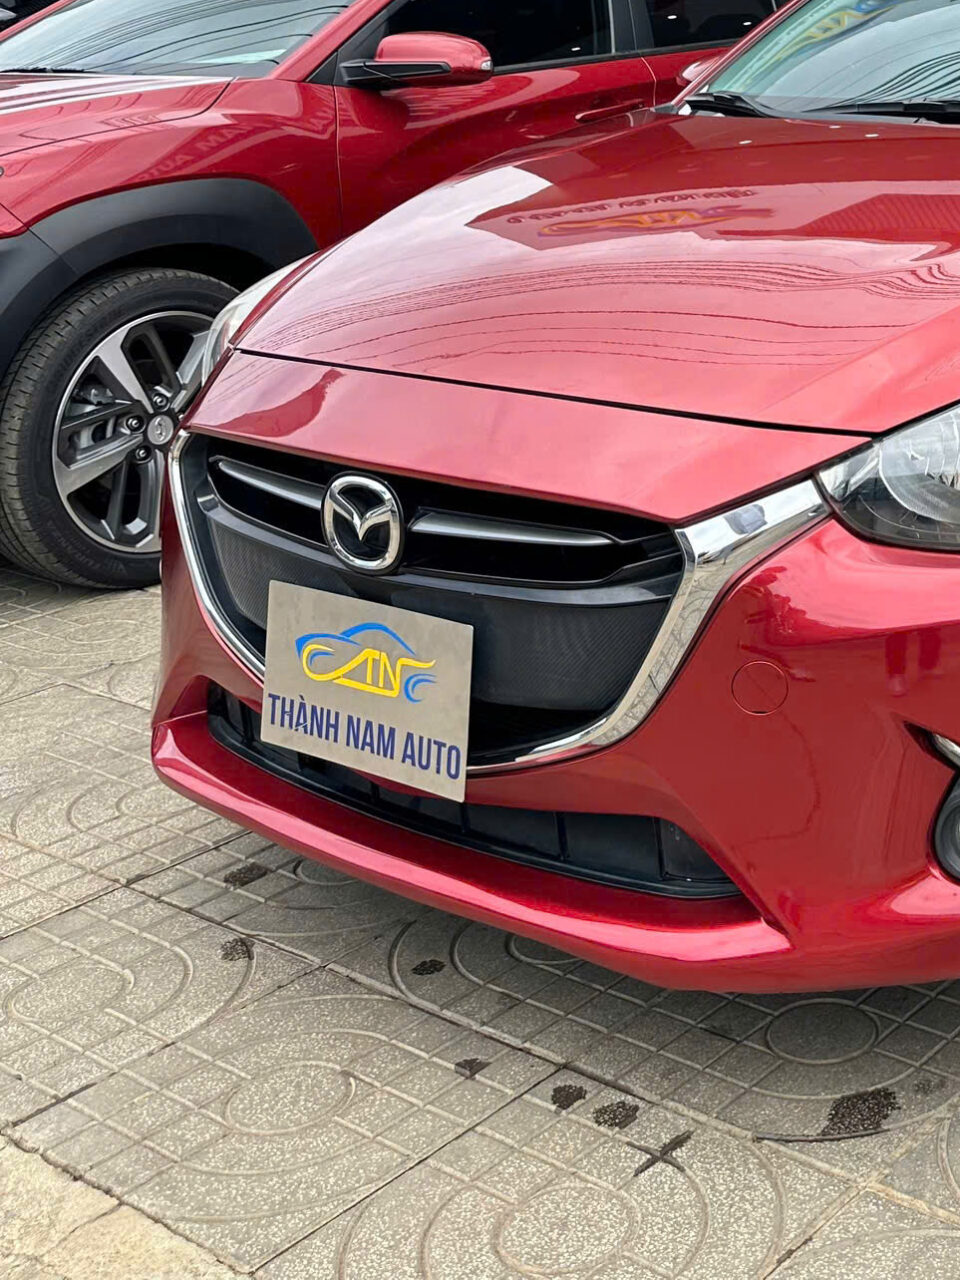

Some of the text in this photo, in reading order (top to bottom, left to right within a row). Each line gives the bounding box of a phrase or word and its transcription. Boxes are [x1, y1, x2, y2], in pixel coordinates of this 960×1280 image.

[268, 693, 461, 780] THÀNH NAM AUTO
